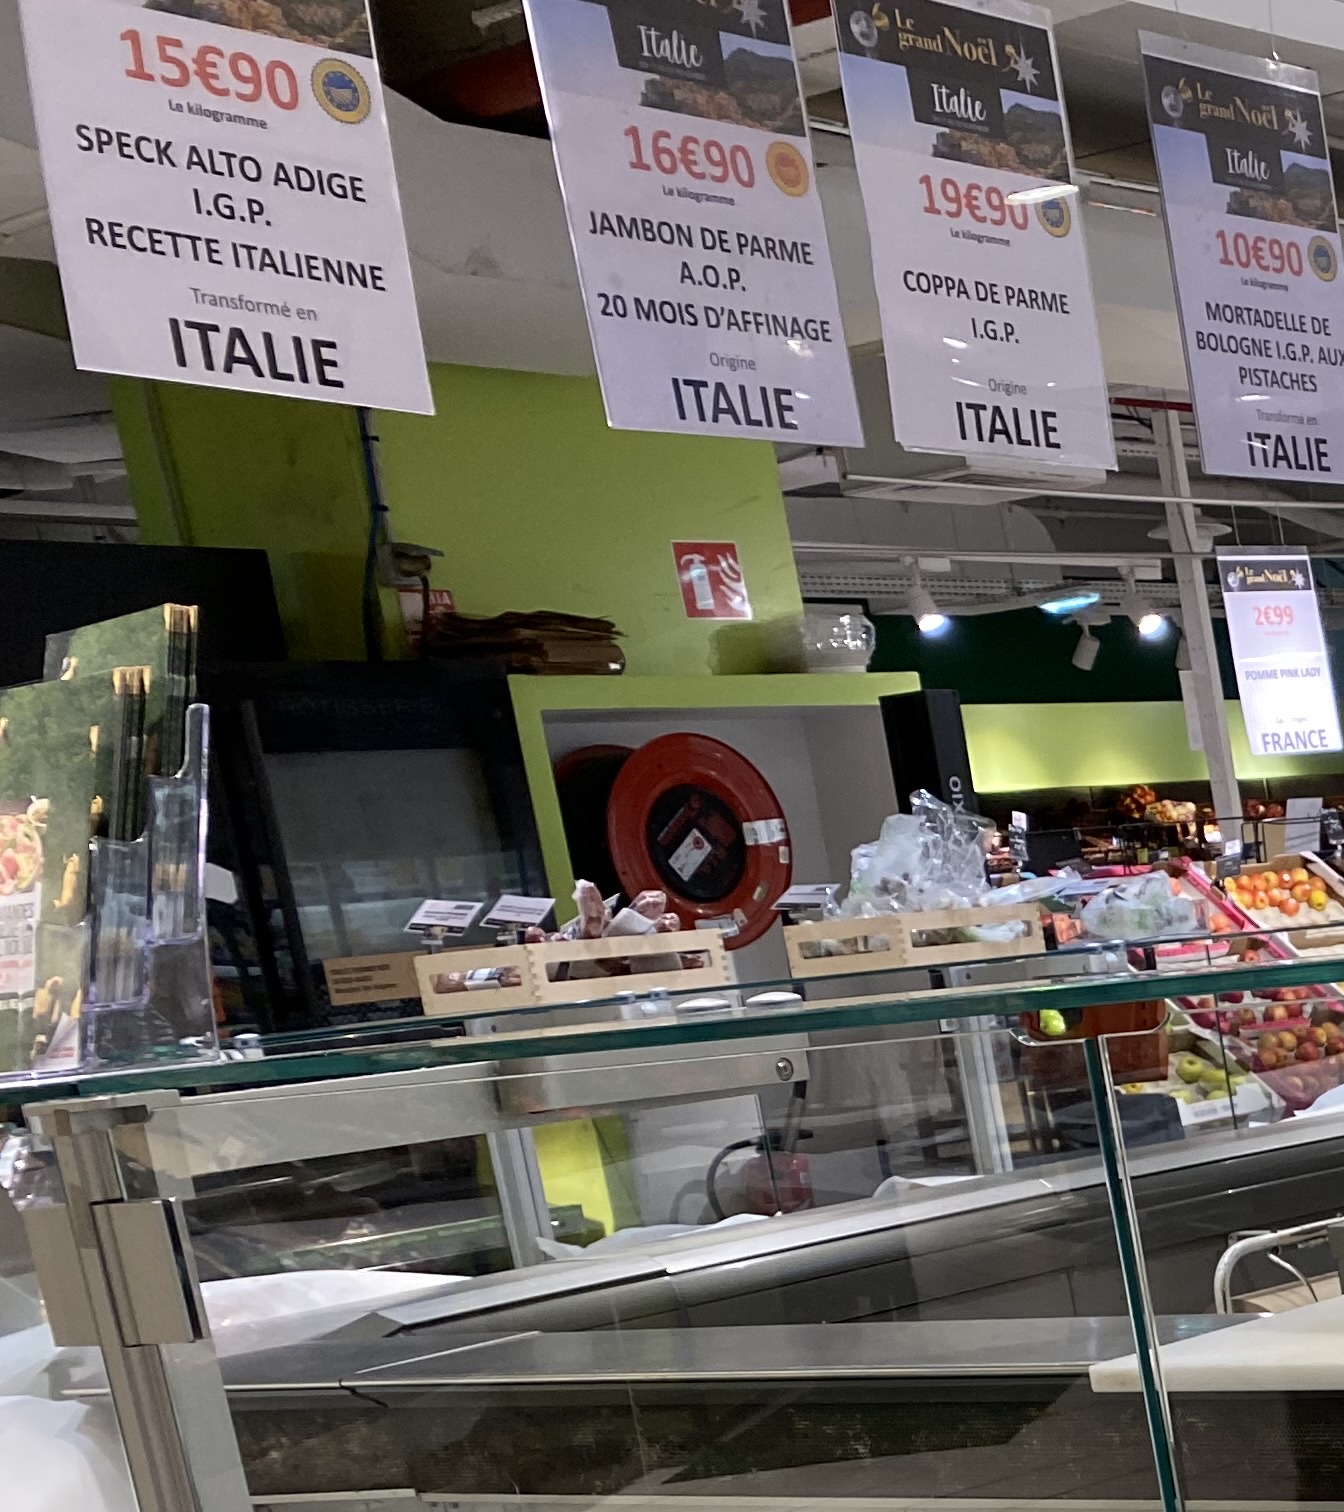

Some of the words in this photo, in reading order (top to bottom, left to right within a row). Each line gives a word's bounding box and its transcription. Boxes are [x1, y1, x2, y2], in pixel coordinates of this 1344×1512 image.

[638, 25, 703, 68] Italie
[944, 26, 998, 67] Noël
[120, 29, 299, 111] 15€90
[168, 99, 183, 113] Le
[187, 101, 268, 130] kilogramme
[931, 83, 986, 122] Italie
[76, 124, 176, 168] SPECK
[186, 145, 263, 183] ALTO
[273, 161, 367, 203] ADIGE
[624, 125, 755, 188] 16€90
[1225, 148, 1271, 181] Italie
[193, 188, 273, 226] I.G.P.
[919, 174, 1029, 231] 19€90
[85, 217, 223, 266] RECETTE
[232, 242, 386, 292] ITALIENNE
[589, 211, 693, 248] JAMBON
[700, 227, 731, 253] DE
[738, 233, 814, 265] PARME
[1215, 229, 1304, 277] 10€90
[680, 261, 746, 292] A.O.P.
[903, 270, 971, 300] COPPA
[974, 281, 1001, 304] DE
[1004, 285, 1070, 314] PARME
[190, 287, 291, 318] Transformé
[296, 307, 318, 322] en
[598, 293, 627, 318] 20
[634, 297, 698, 326] MOIS
[1205, 301, 1308, 333] MORTADELLE
[1311, 316, 1332, 336] DE
[971, 318, 1020, 344] I.G.P.
[1195, 331, 1273, 359] BOLOGNE
[1276, 341, 1314, 364] I.G.P.
[168, 317, 345, 389] ITALIE
[709, 352, 757, 372] Origine
[988, 378, 1027, 396] Origine
[1238, 366, 1318, 392] PISTACHES
[672, 377, 798, 430] ITALIE
[956, 401, 1061, 449] ITALIE
[1246, 431, 1332, 473] ITALIE
[1253, 604, 1294, 627] 2€99
[1245, 668, 1278, 681] POMME
[1280, 668, 1300, 679] PINK
[1301, 667, 1321, 678] LADY
[1261, 729, 1329, 753] FRANCE
